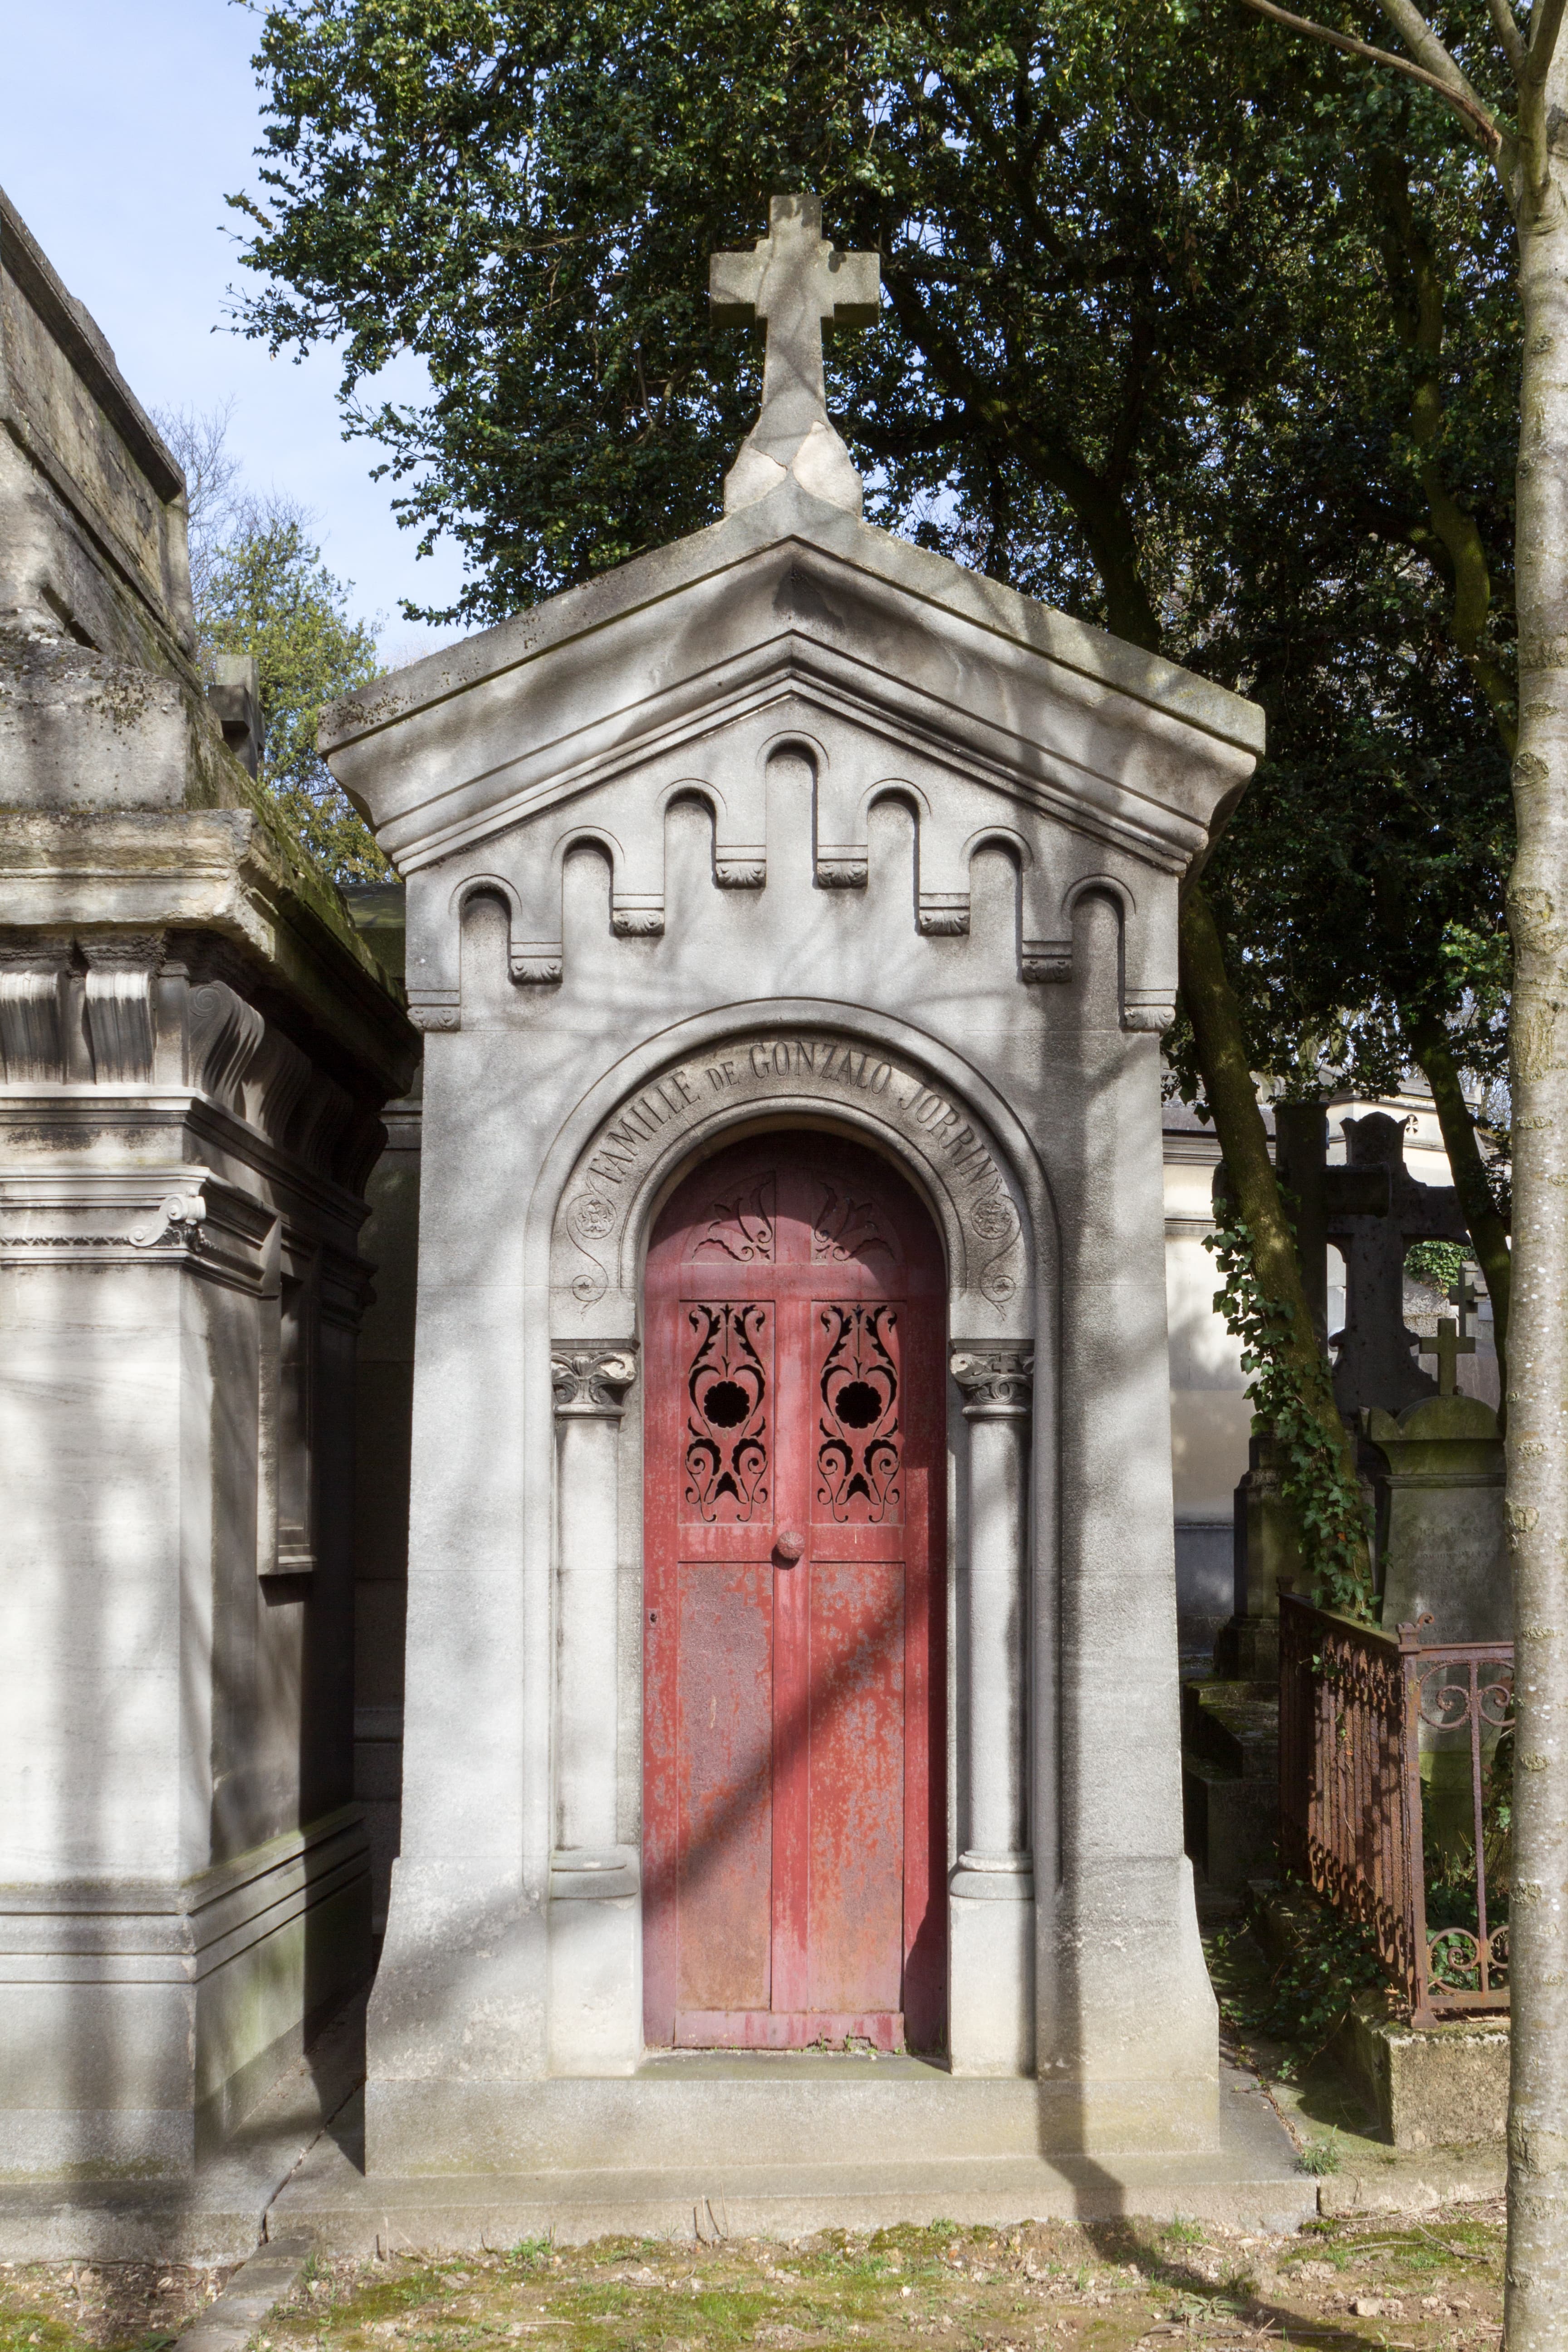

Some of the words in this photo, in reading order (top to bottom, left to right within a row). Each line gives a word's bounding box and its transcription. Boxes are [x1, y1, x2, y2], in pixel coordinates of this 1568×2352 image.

[588, 1071, 701, 1184] FAMILLE
[706, 1061, 740, 1091] DE
[749, 1041, 892, 1095] GONZALO
[897, 1086, 998, 1188] JORRIN
